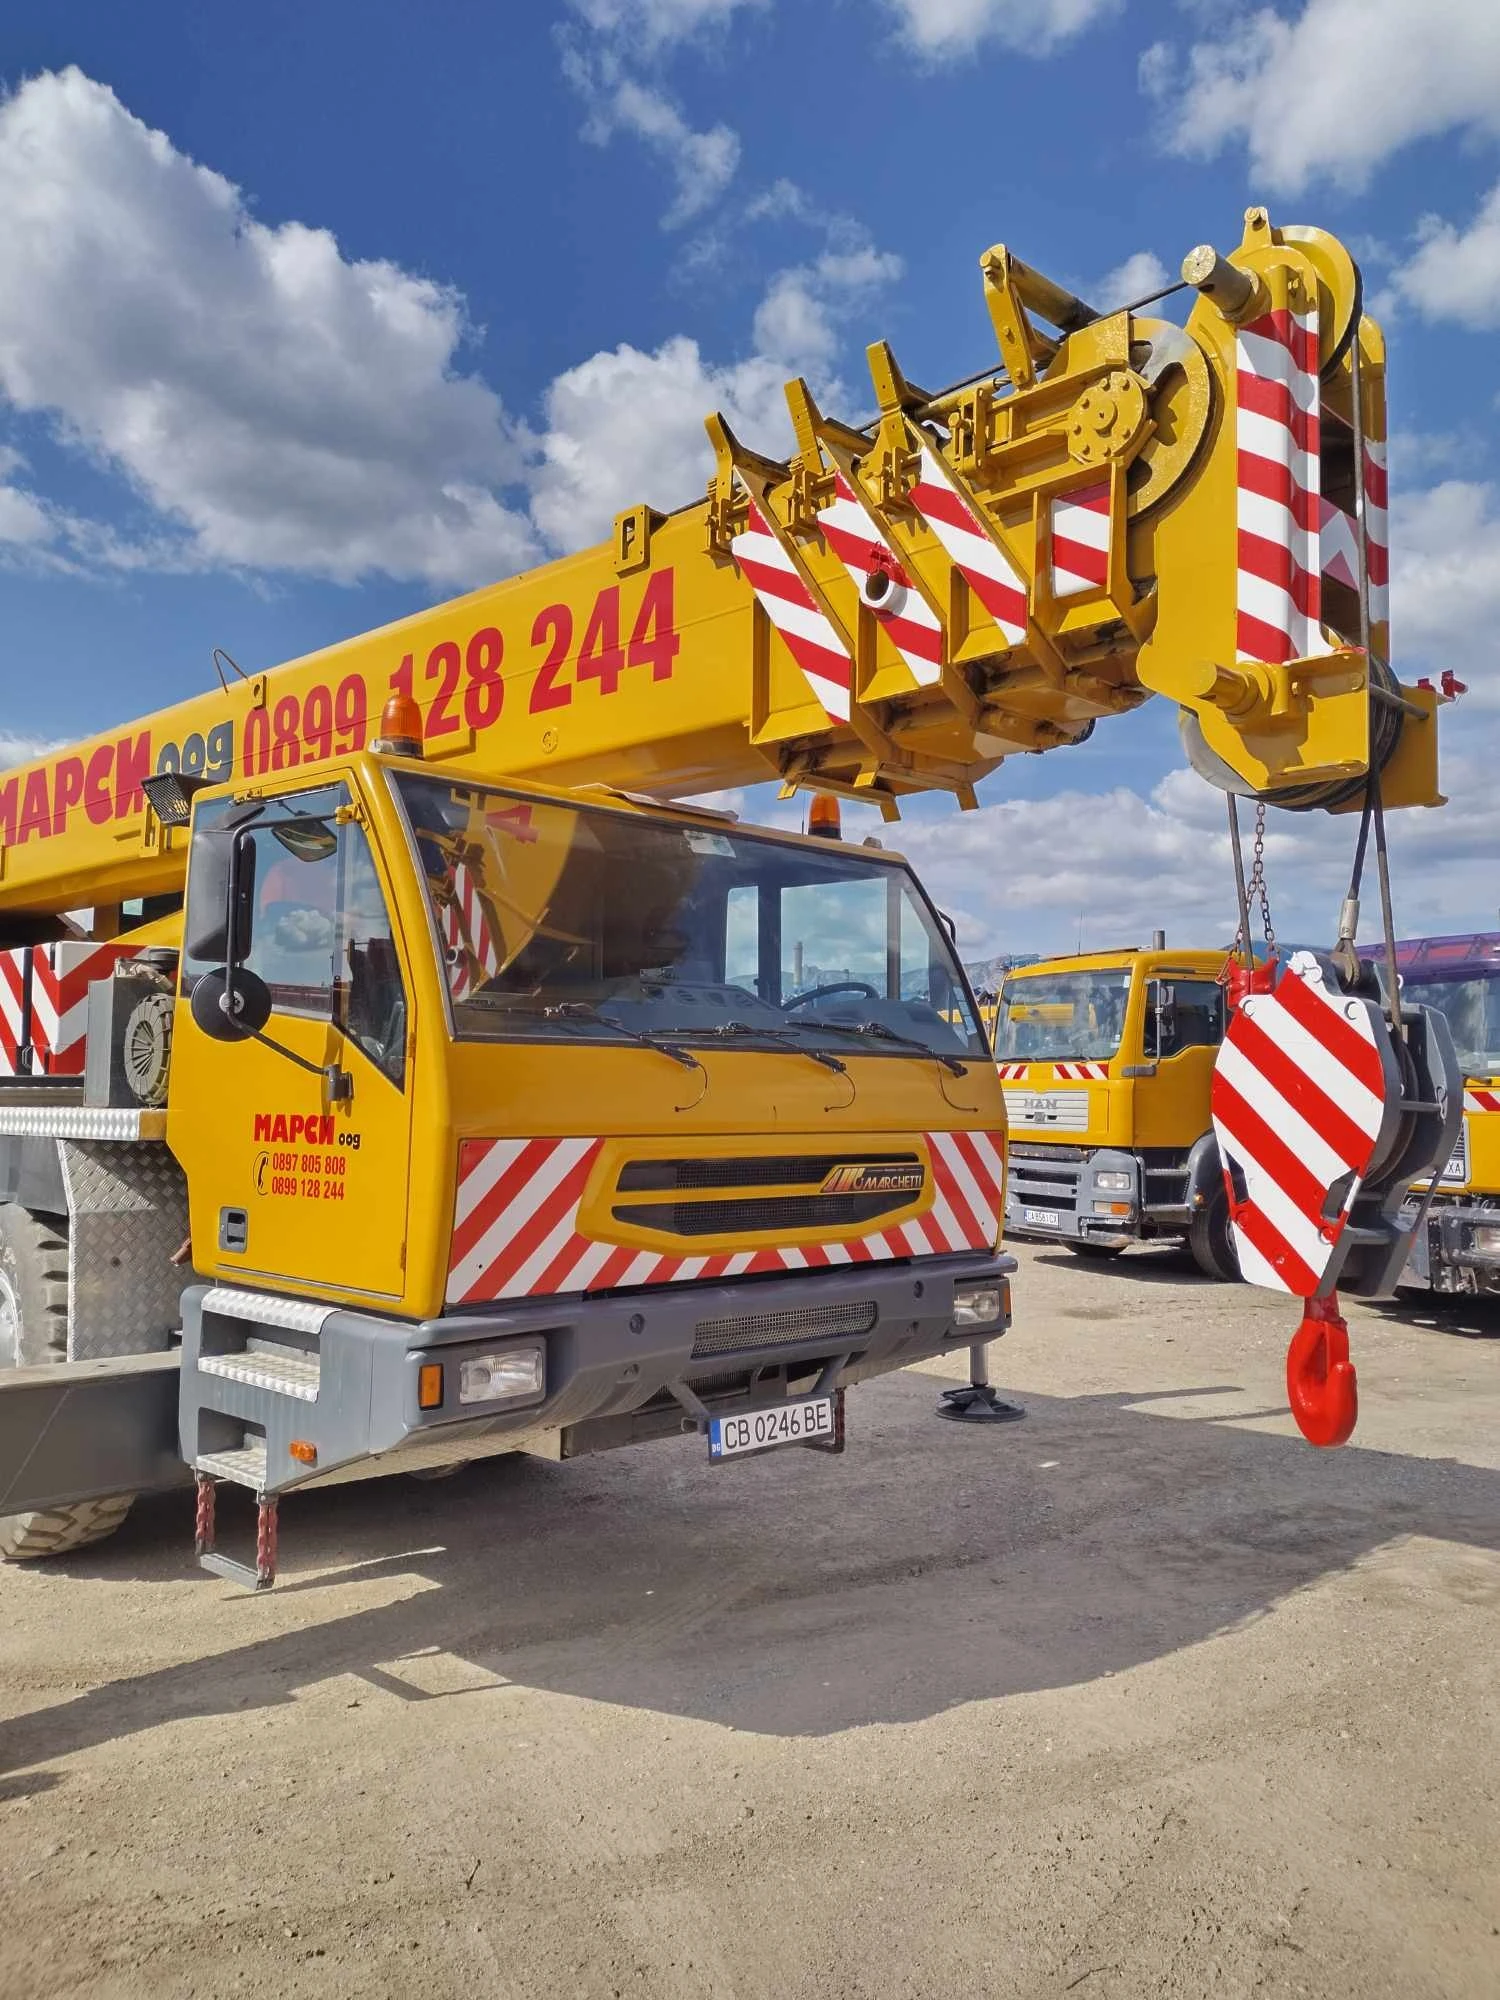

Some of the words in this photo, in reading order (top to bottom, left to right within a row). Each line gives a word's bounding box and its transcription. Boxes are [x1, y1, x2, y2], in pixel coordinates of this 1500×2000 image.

[243, 673, 368, 778] 0899
[529, 566, 681, 715] 244
[254, 1113, 335, 1145] МАРСИ
[272, 1152, 298, 1172] 0897
[301, 1154, 321, 1174] 805
[325, 1156, 346, 1176] 808
[271, 1176, 297, 1196] 0899
[301, 1178, 320, 1198] 128
[324, 1181, 345, 1201] 244
[724, 1419, 751, 1450] CB
[754, 1409, 801, 1442] 0246
[804, 1403, 828, 1432] BE
